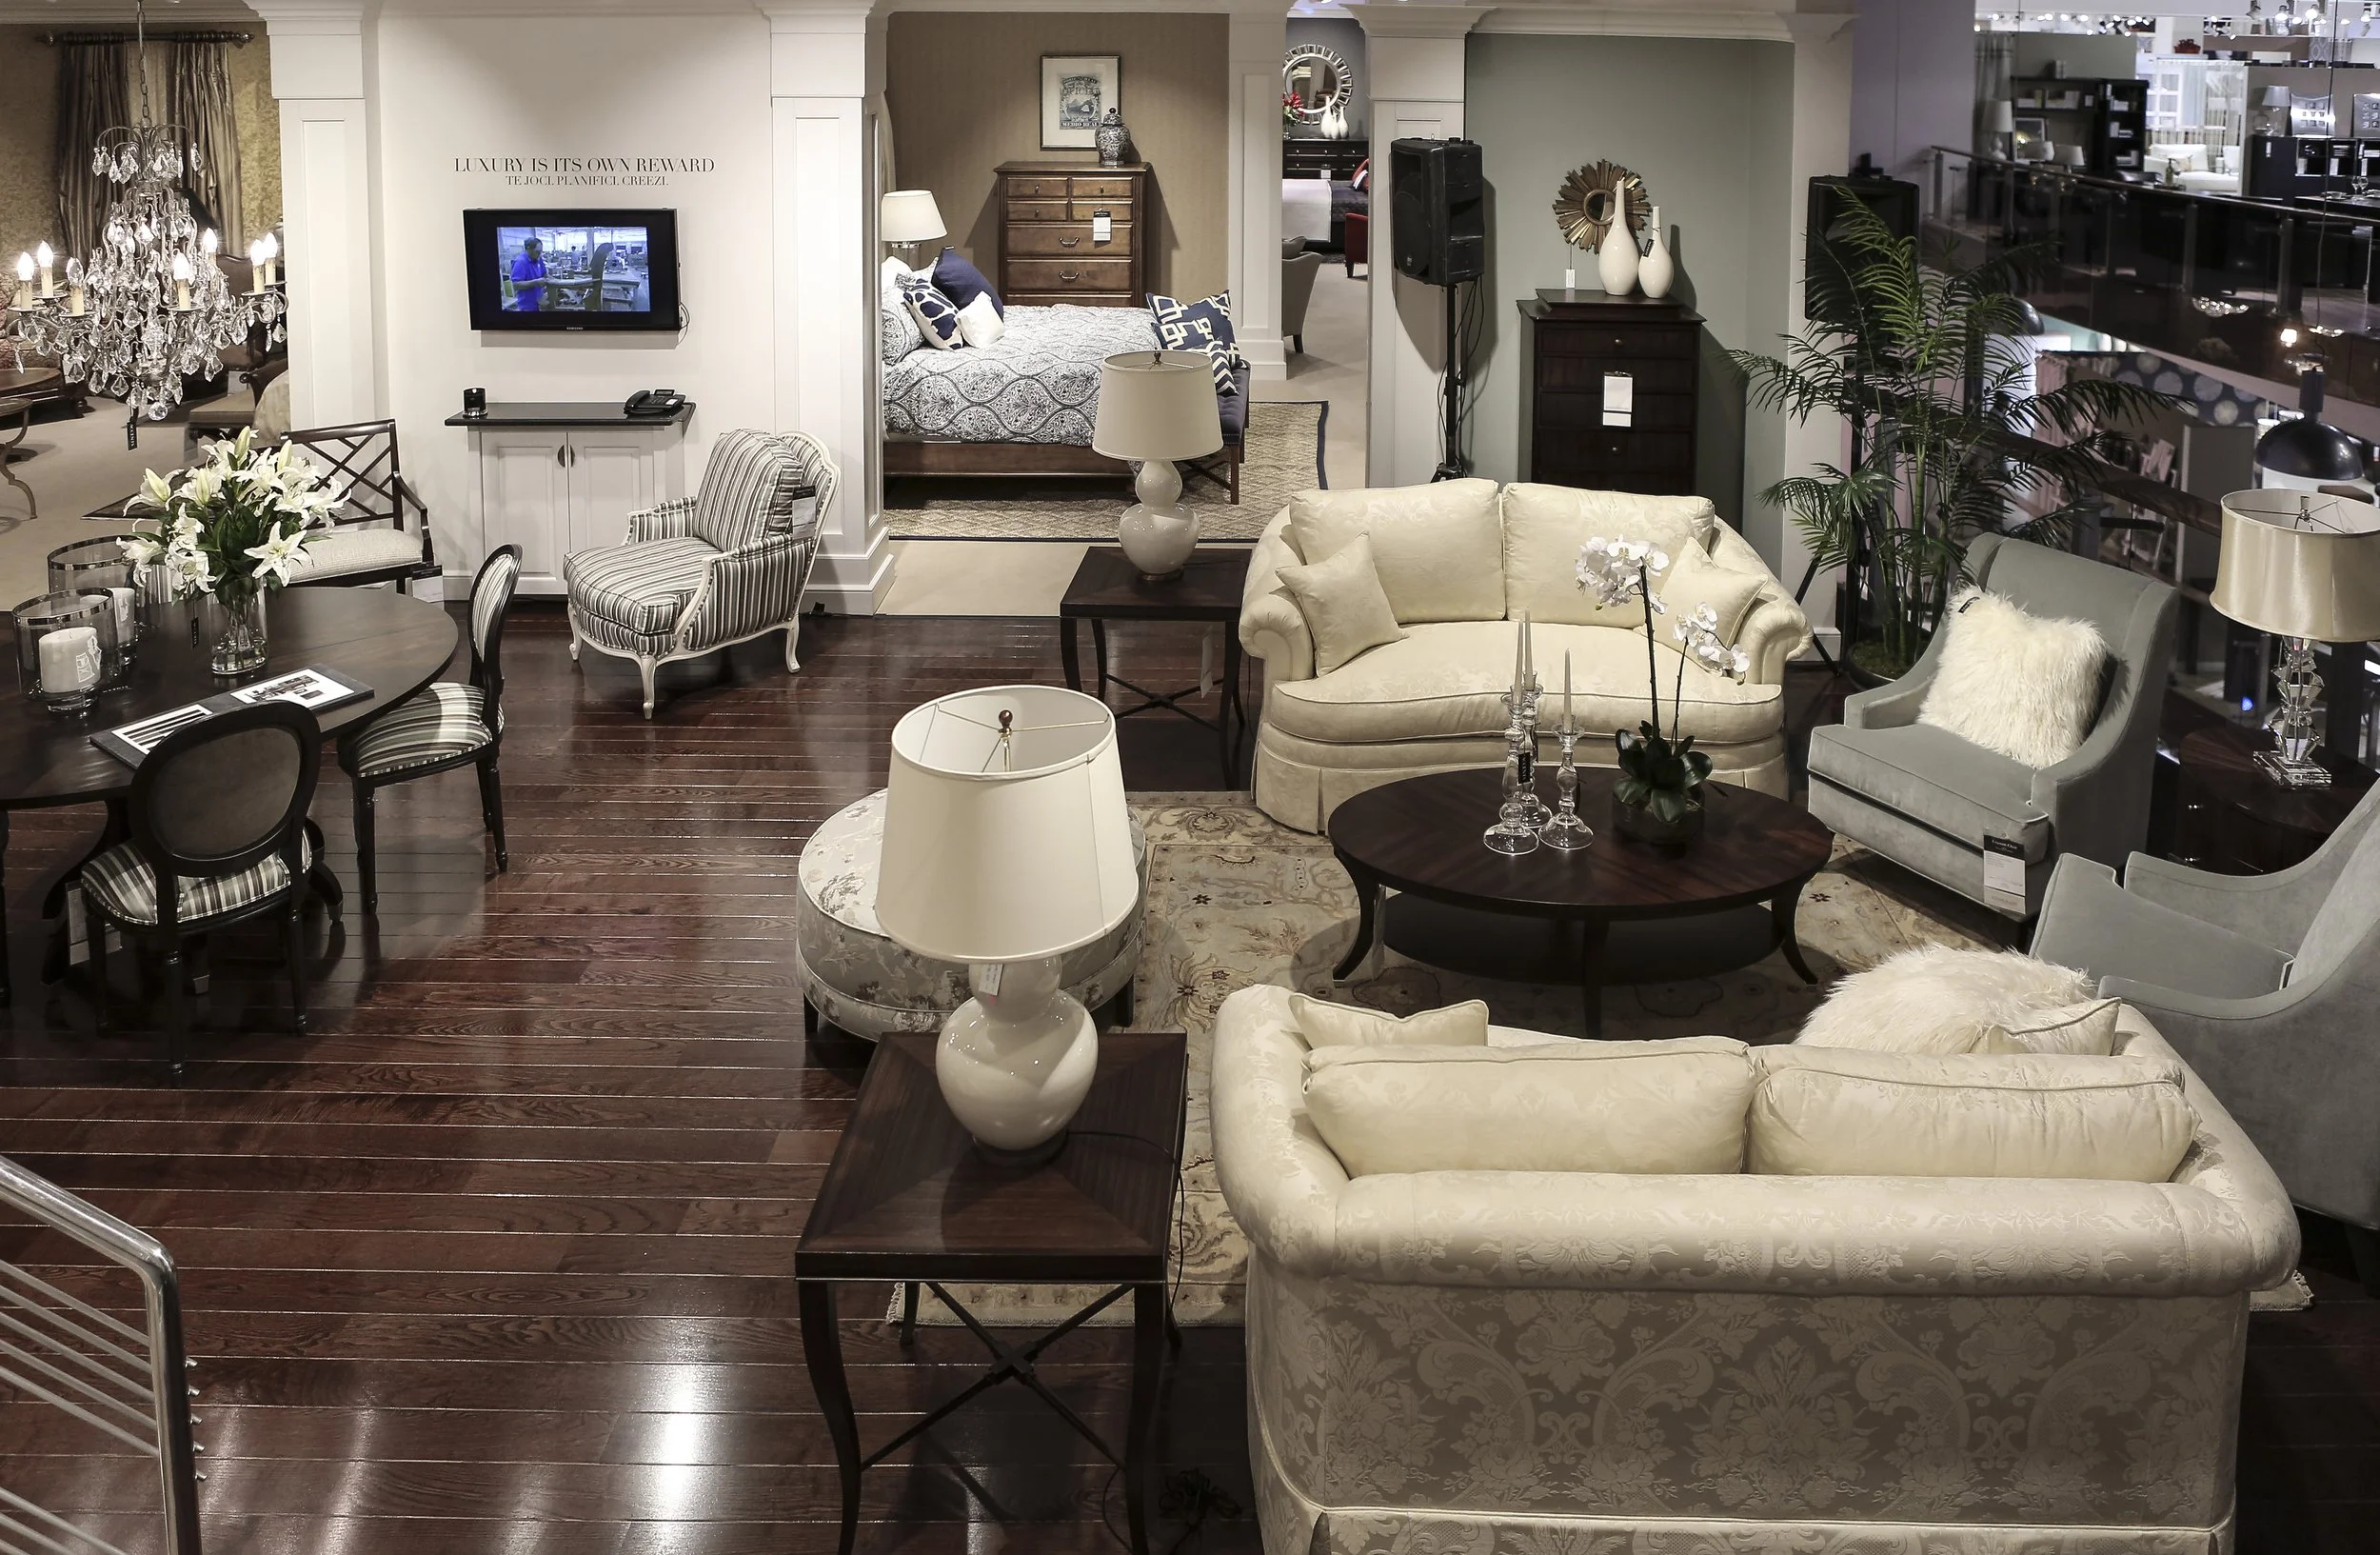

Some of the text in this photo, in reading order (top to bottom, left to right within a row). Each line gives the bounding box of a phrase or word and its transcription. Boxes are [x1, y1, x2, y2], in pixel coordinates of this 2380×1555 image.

[453, 157, 715, 172] LUXURY IS ITS OWN REWARD
[506, 175, 522, 186] TE
[557, 175, 619, 186] PLANIFICI.
[622, 175, 669, 186] CREEZI.
